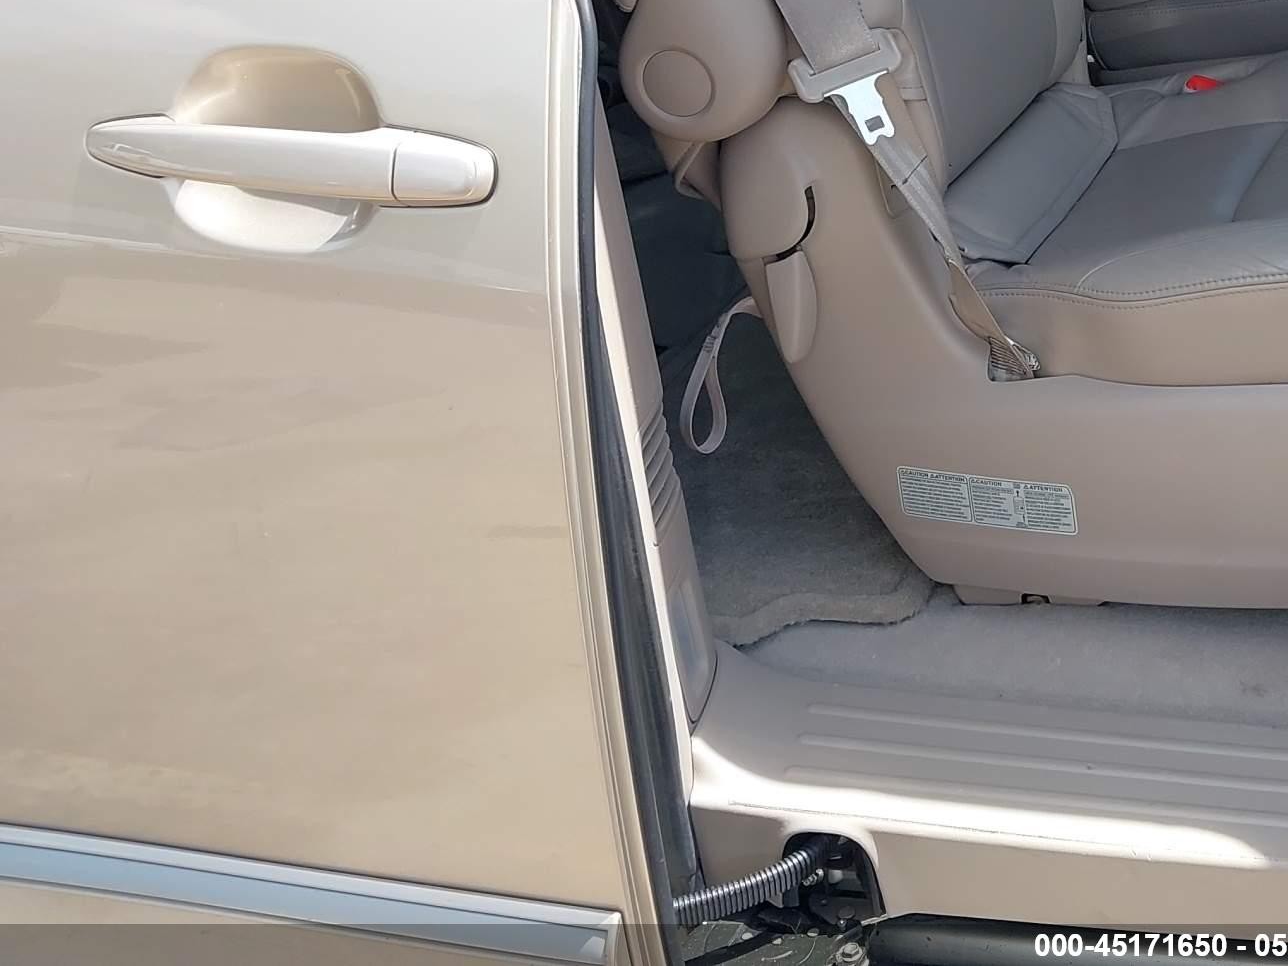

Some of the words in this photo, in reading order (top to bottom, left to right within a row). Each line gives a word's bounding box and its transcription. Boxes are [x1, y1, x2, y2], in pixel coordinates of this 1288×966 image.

[905, 470, 929, 478] CAUTION
[934, 474, 965, 482] ATTENTION
[975, 479, 1003, 487] CAUTION
[1028, 485, 1064, 493] ATTENTION
